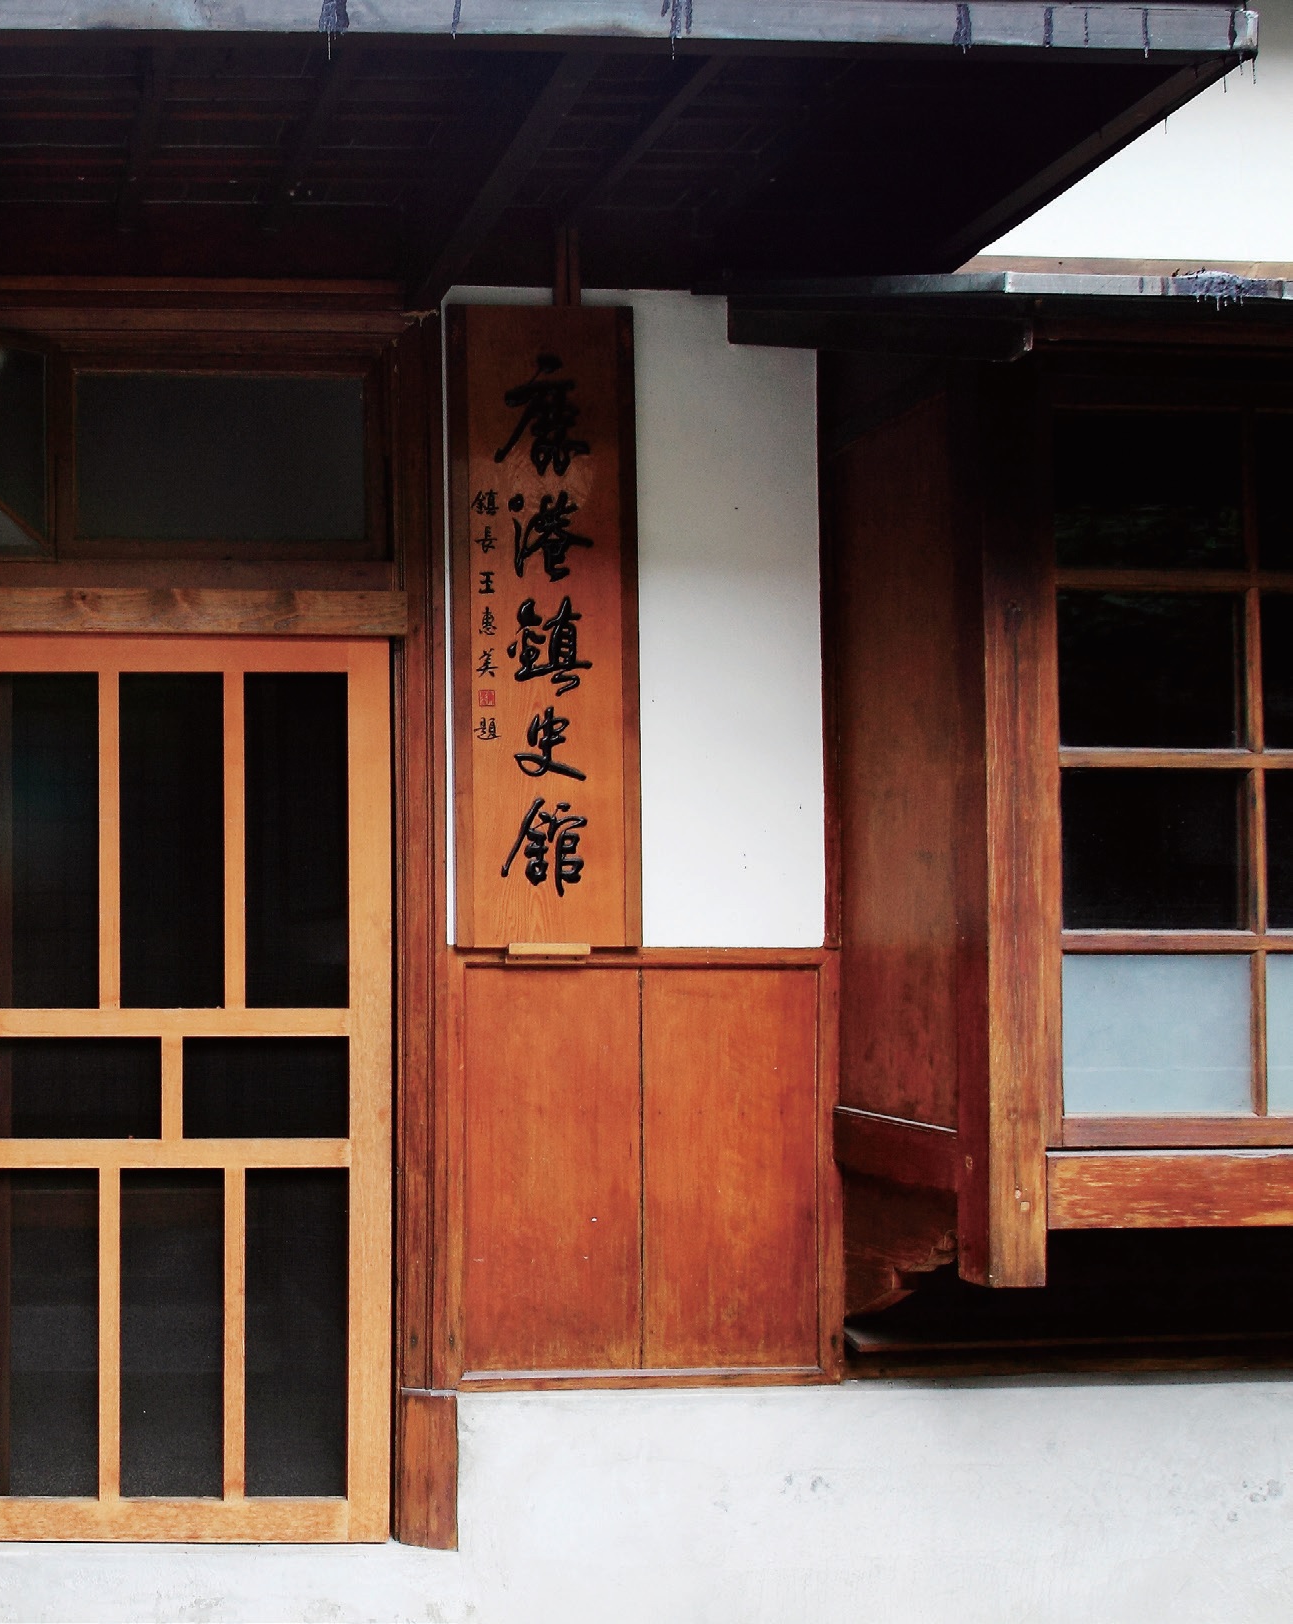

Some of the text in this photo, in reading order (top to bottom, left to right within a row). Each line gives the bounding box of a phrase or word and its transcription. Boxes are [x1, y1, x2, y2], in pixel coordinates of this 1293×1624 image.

[494, 353, 594, 898] 鹿港鎮史館
